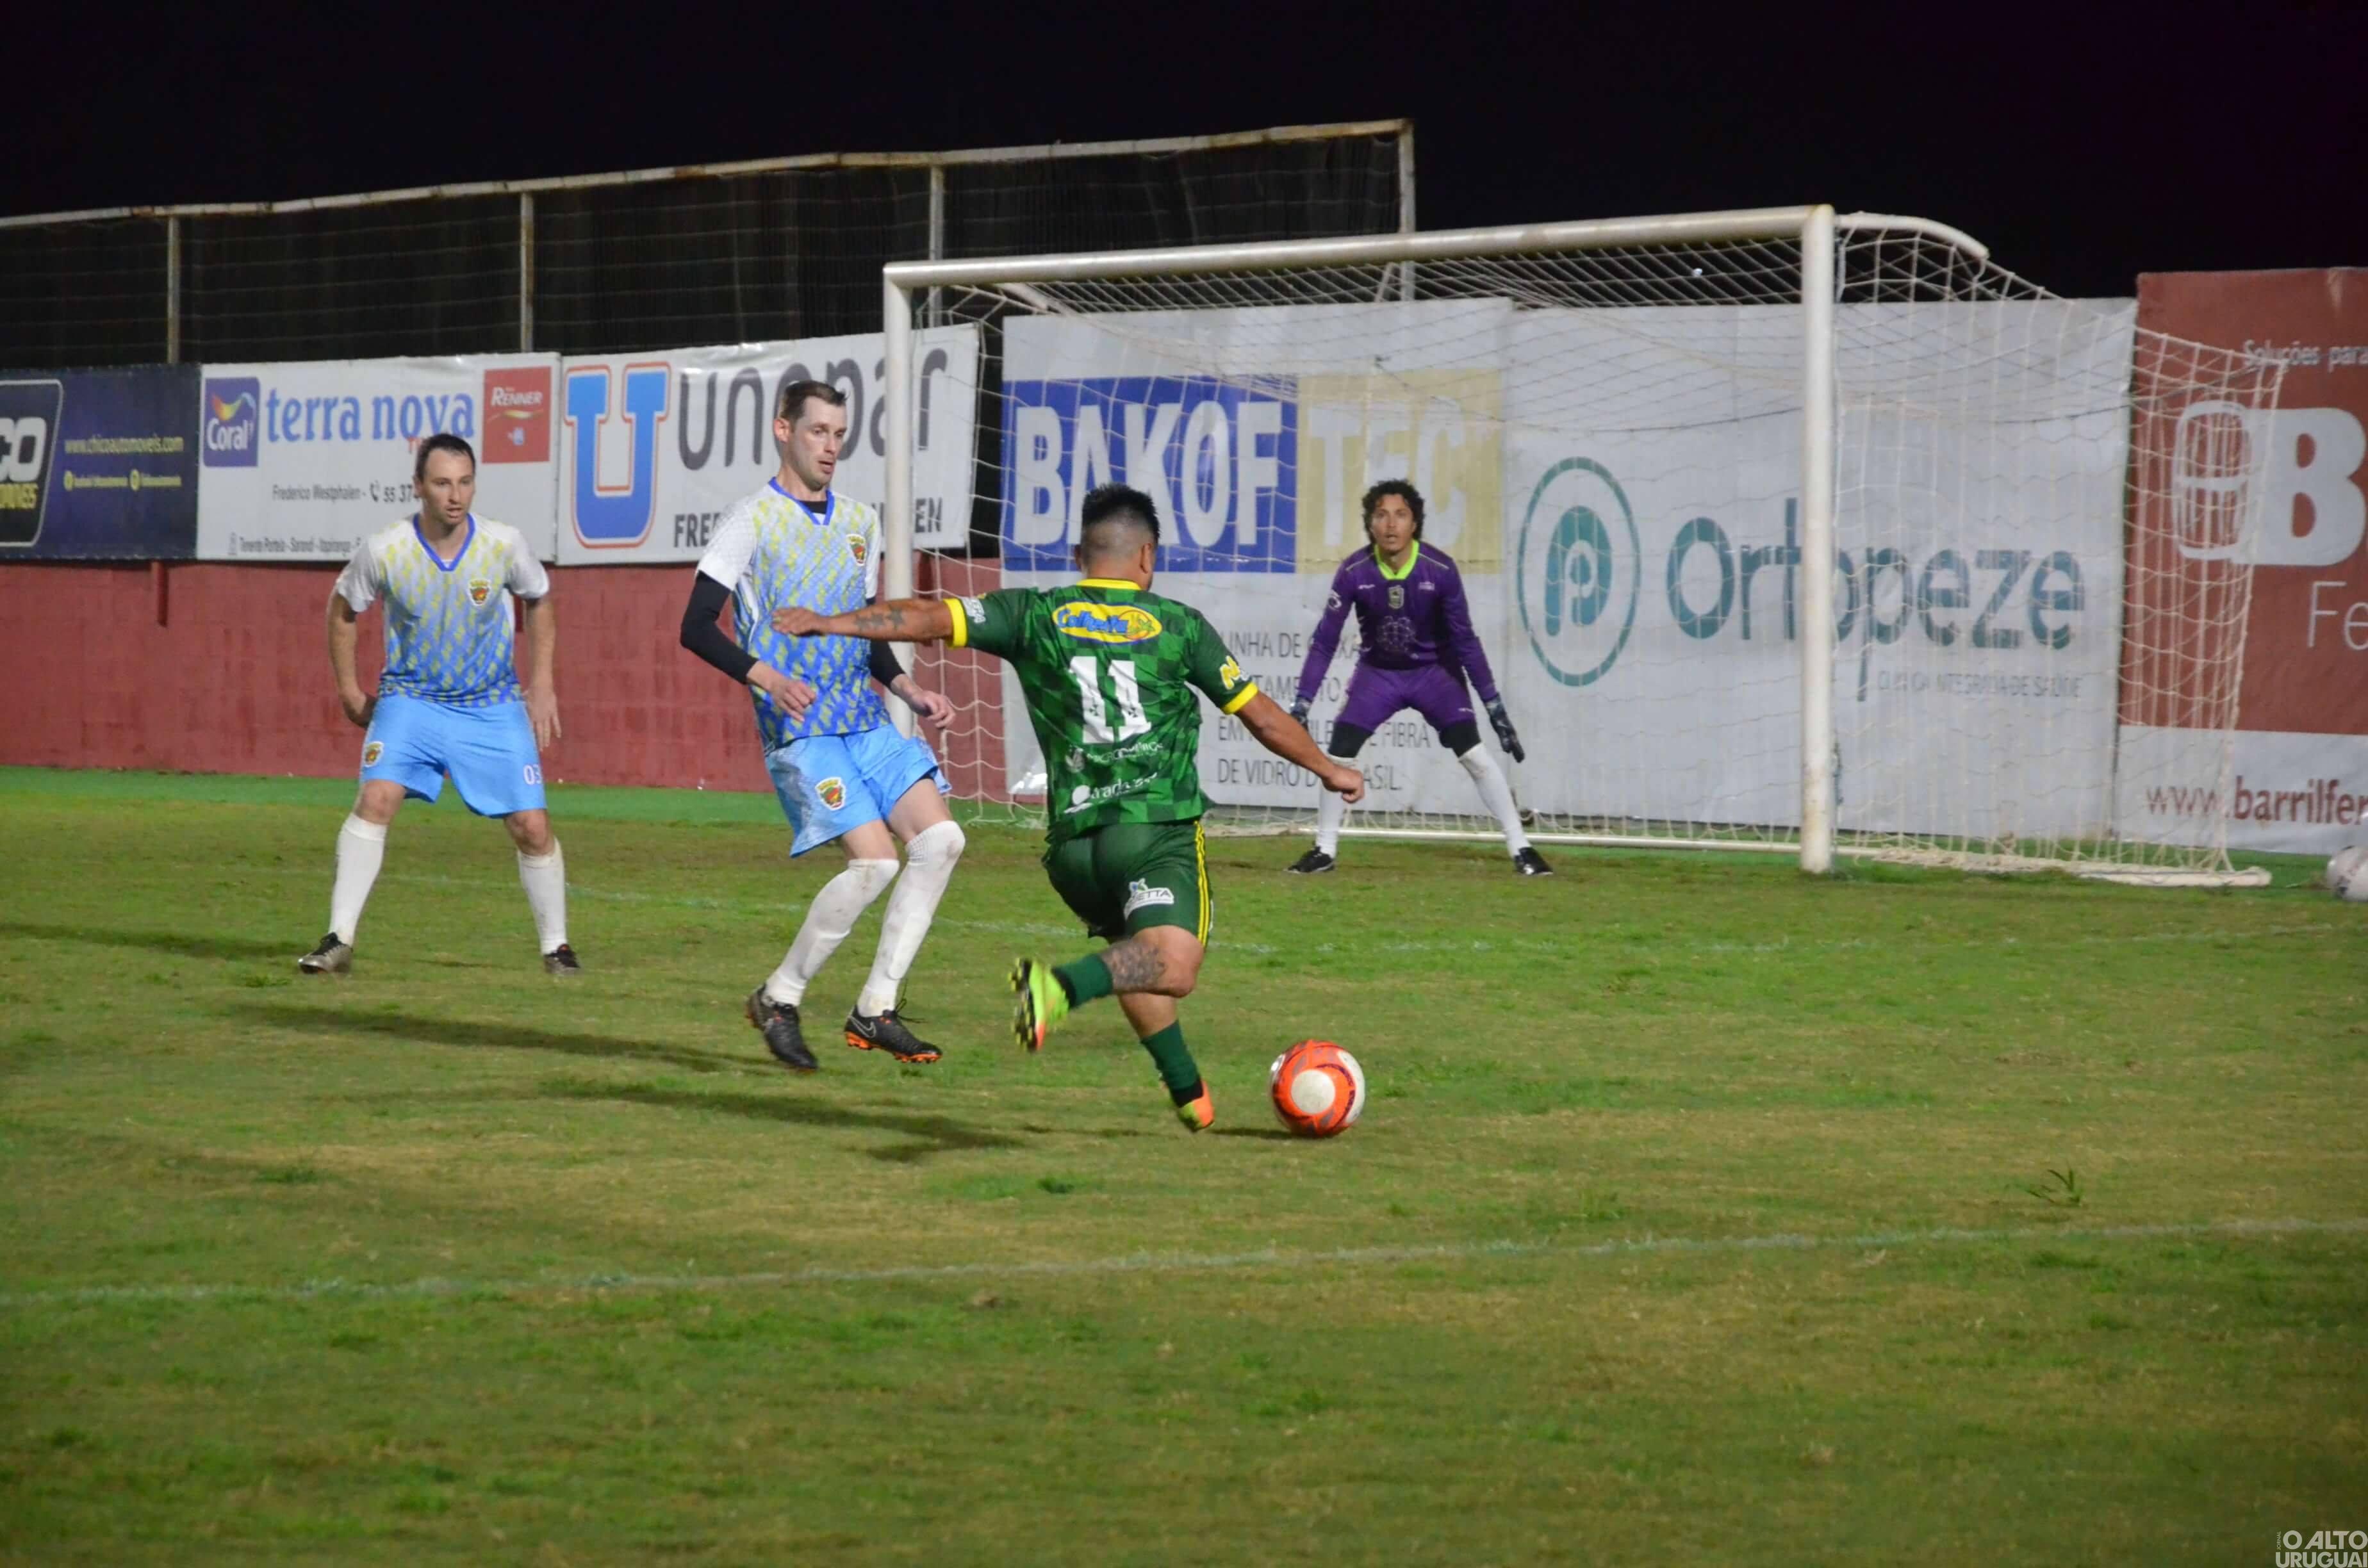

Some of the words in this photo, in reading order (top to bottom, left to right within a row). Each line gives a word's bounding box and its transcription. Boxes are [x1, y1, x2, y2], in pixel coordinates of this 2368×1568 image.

[491, 386, 543, 406] RENNER
[267, 388, 361, 442] terra
[372, 392, 475, 440] nova
[206, 418, 251, 452] Coral
[1012, 400, 1281, 546] BAKOF
[1308, 392, 1467, 548] TEC
[399, 484, 420, 502] 37
[1222, 630, 1272, 658] INHA
[1279, 632, 1301, 658] DE
[1068, 655, 1153, 745] 11
[1383, 721, 1432, 748] FIBRA
[1218, 758, 1239, 783] DE
[1246, 760, 1301, 787] VIDRO
